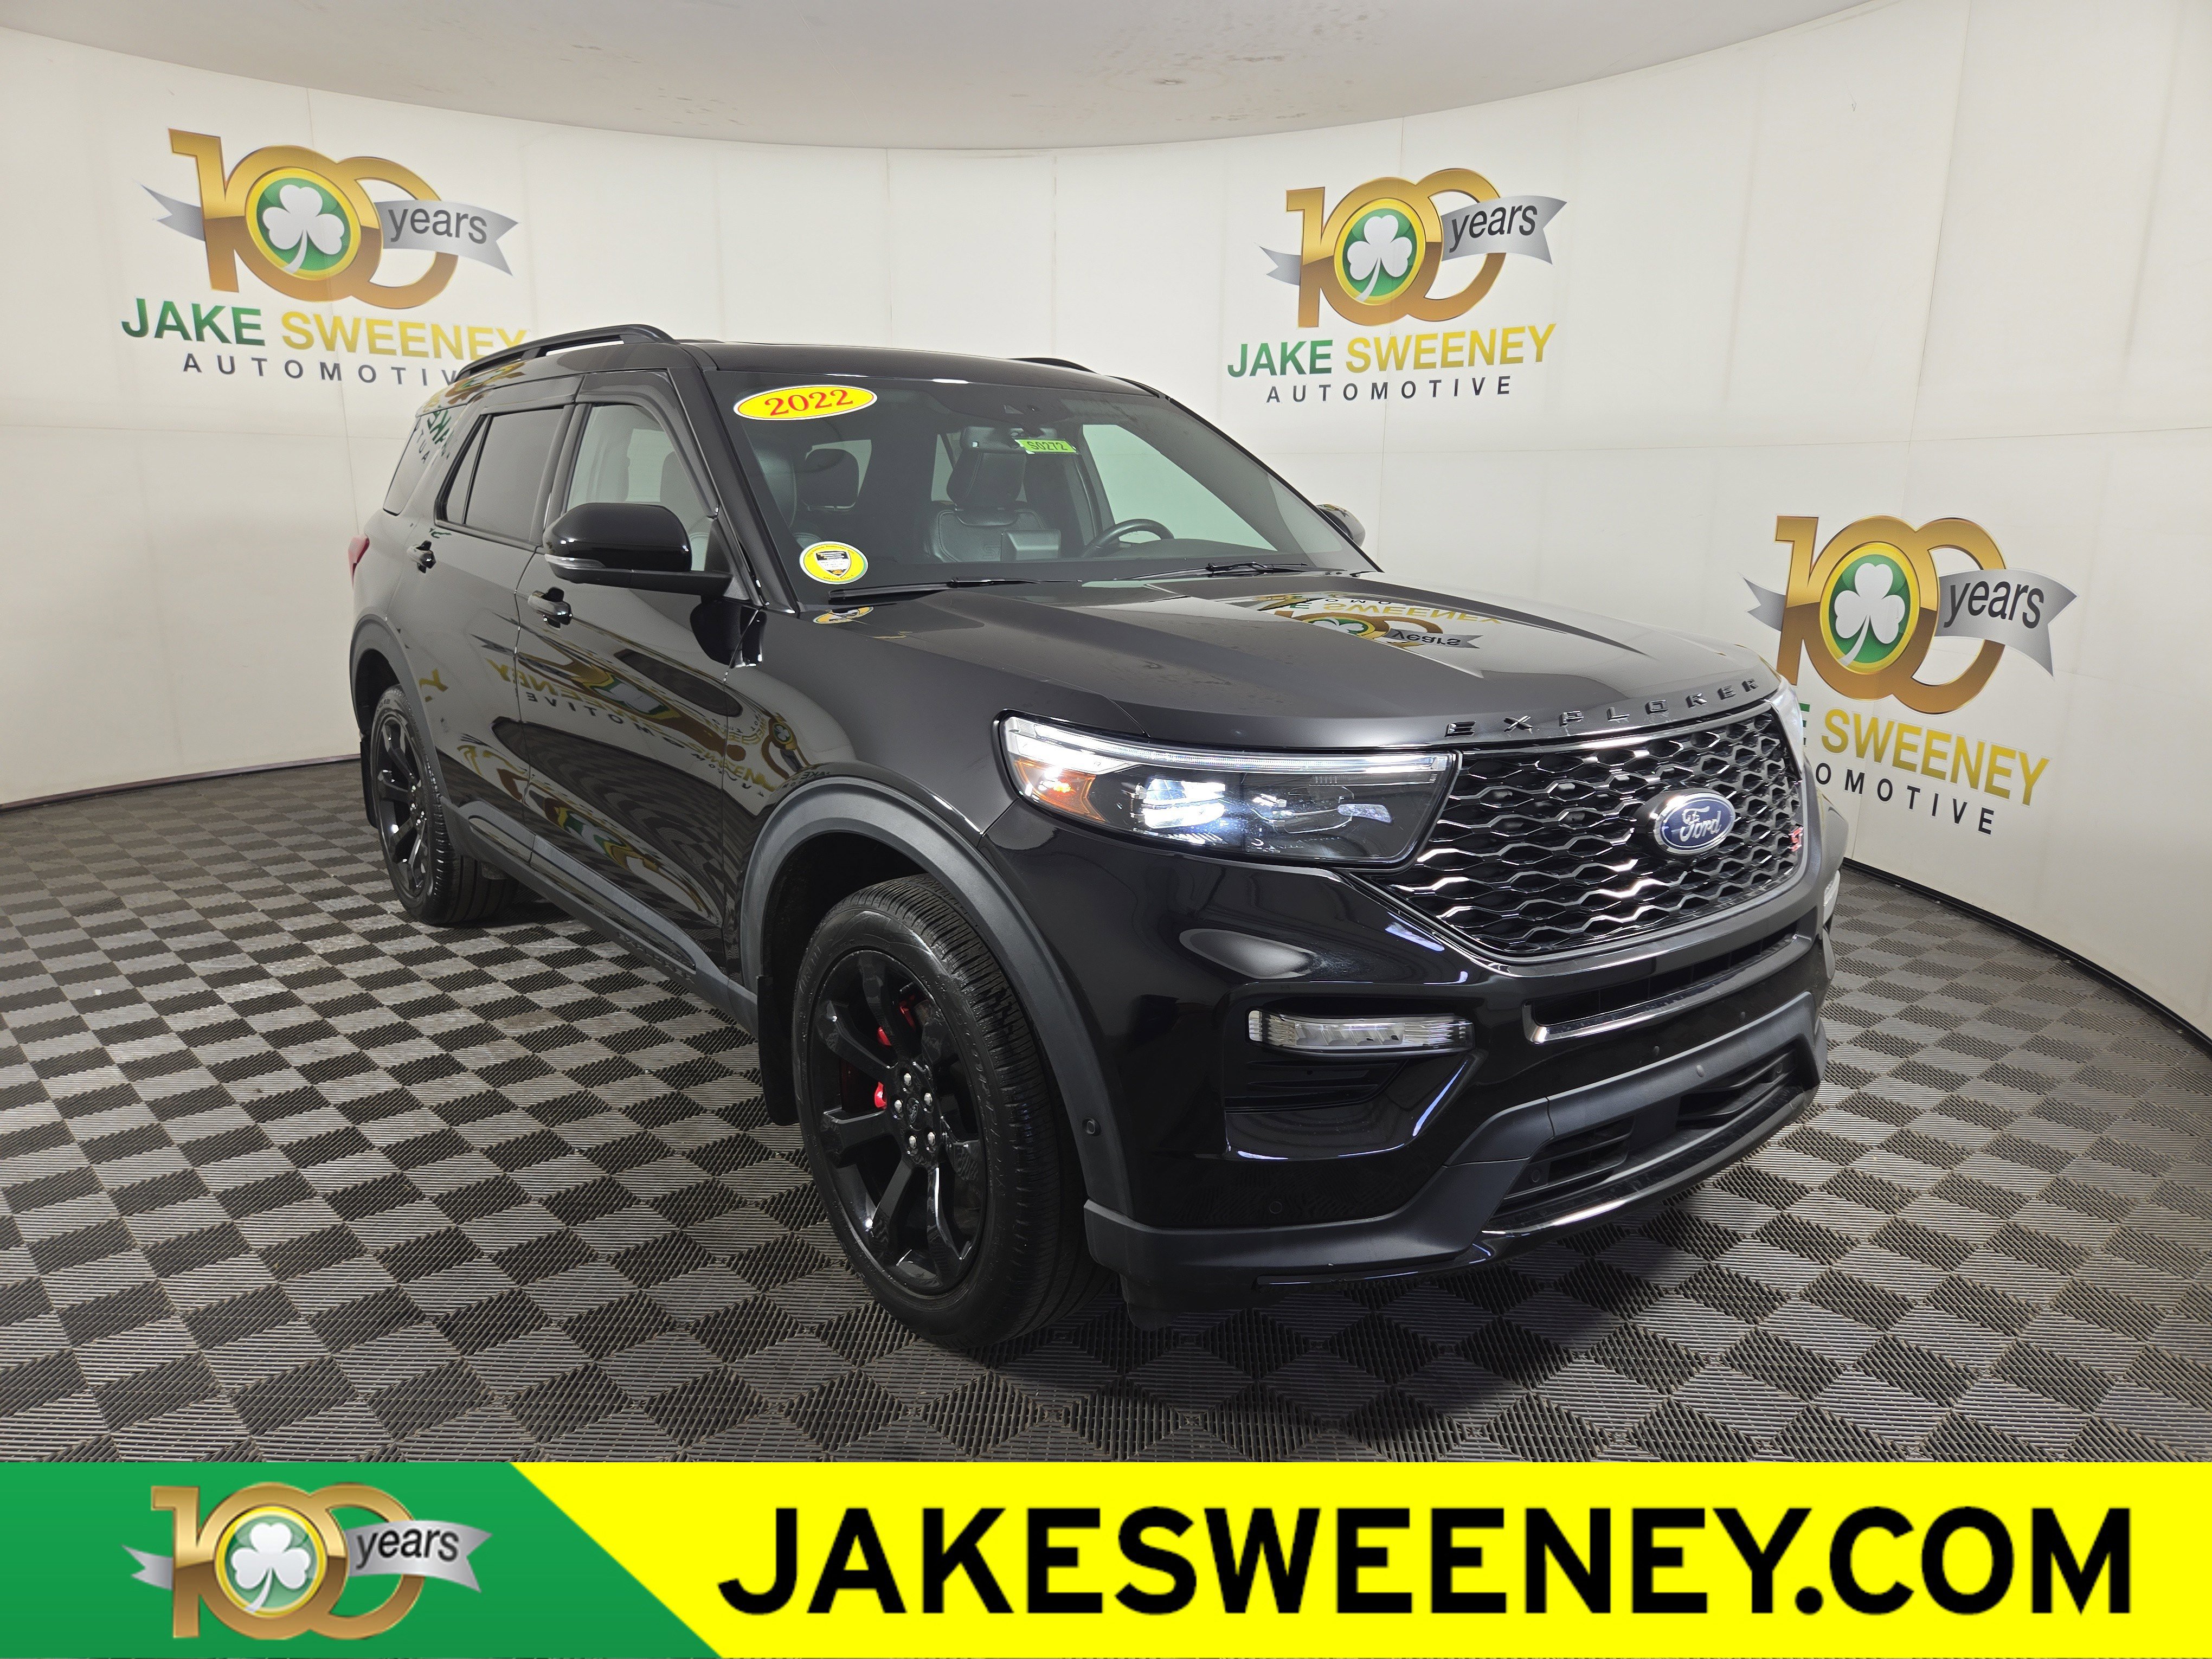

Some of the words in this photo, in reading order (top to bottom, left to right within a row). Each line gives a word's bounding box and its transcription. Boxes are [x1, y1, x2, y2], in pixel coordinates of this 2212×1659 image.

[168, 128, 458, 309] 100
[388, 205, 487, 245] years
[1285, 168, 1507, 328] 100
[1449, 203, 1538, 253] years
[121, 298, 266, 346] JAKE
[282, 311, 528, 361] SWEENEY
[1227, 339, 1333, 378] JAKE
[1346, 323, 1557, 374] SWEENEY
[183, 352, 457, 386] AUTOMOTIV
[1266, 375, 1511, 403] AUTOMOTIVE
[764, 389, 853, 416] 2022
[1027, 441, 1068, 451] S0272
[1774, 515, 2006, 715] 100
[1943, 580, 2044, 629] years
[1445, 678, 1759, 737] EXPLORER
[1821, 708, 2050, 806] SWEENEY
[1679, 806, 1722, 842] Ford
[1816, 762, 1995, 835] OMOTIVE
